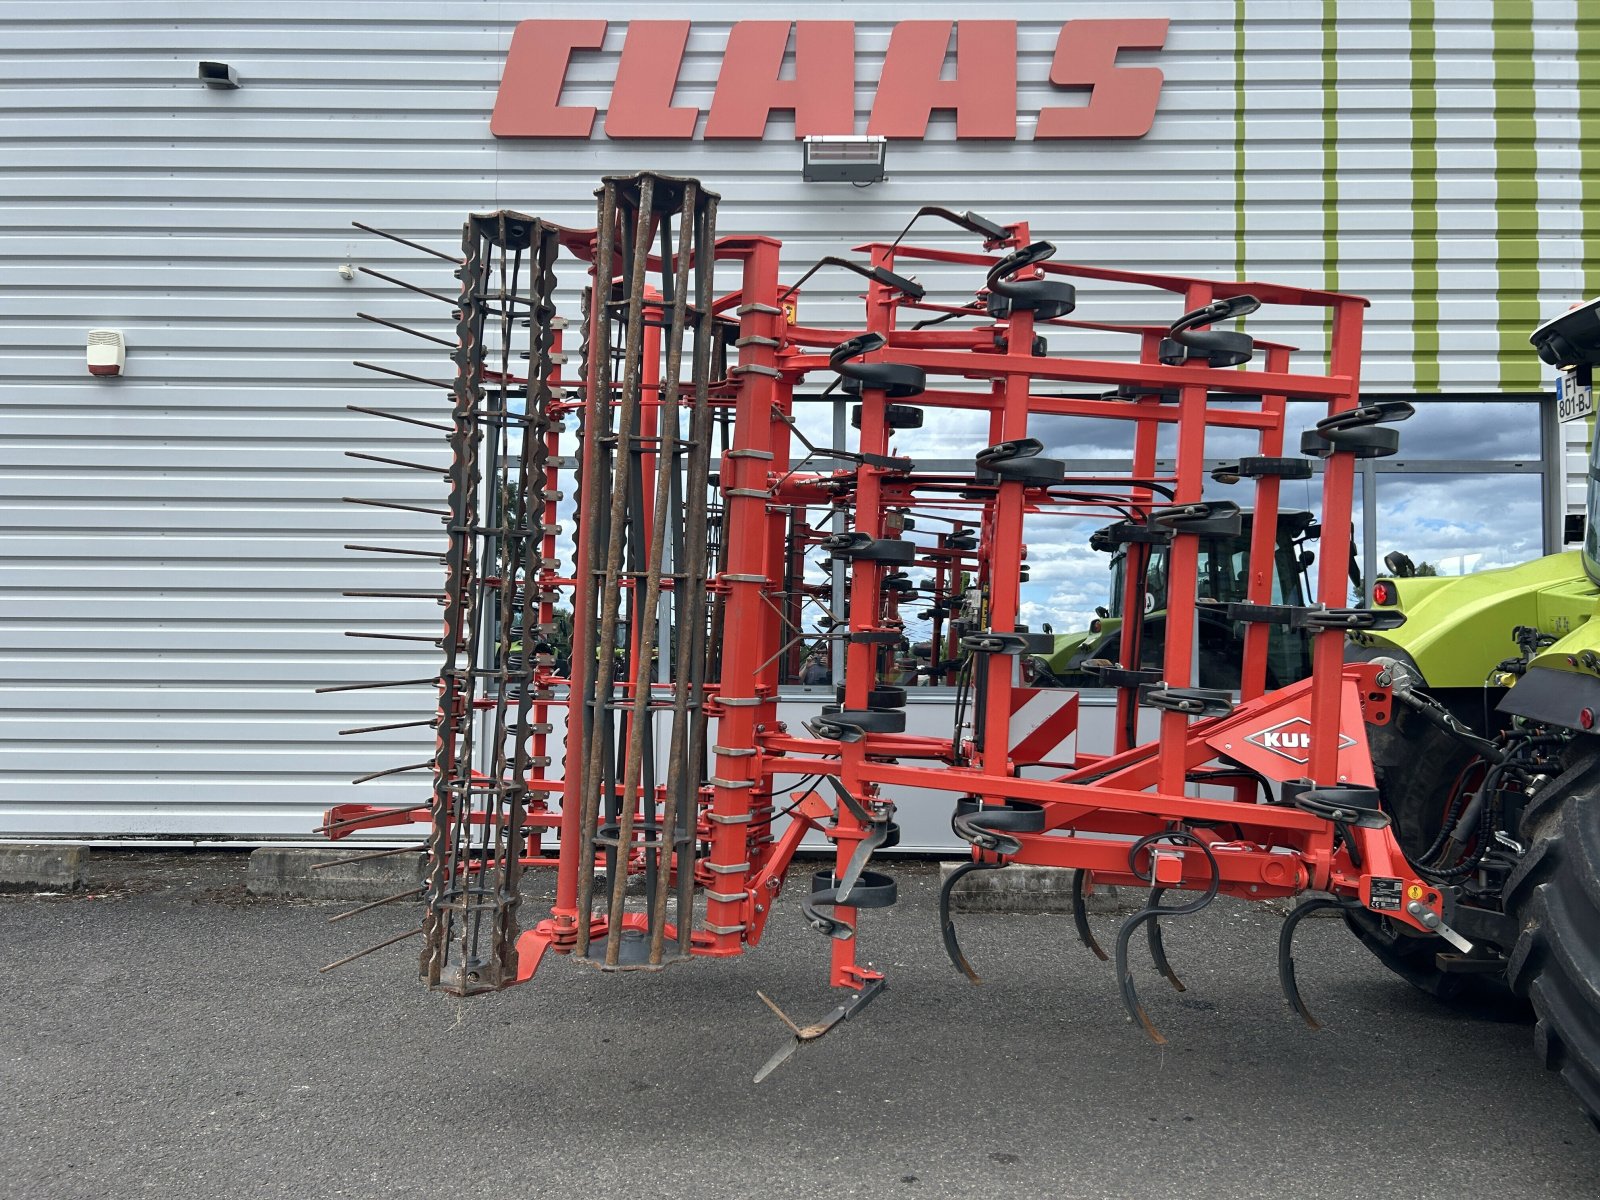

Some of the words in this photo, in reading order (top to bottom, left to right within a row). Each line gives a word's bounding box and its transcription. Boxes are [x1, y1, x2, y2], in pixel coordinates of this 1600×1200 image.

[490, 19, 1170, 140] CLAAS
[1559, 391, 1591, 418] 801-BJ
[1264, 732, 1310, 748] KUH
